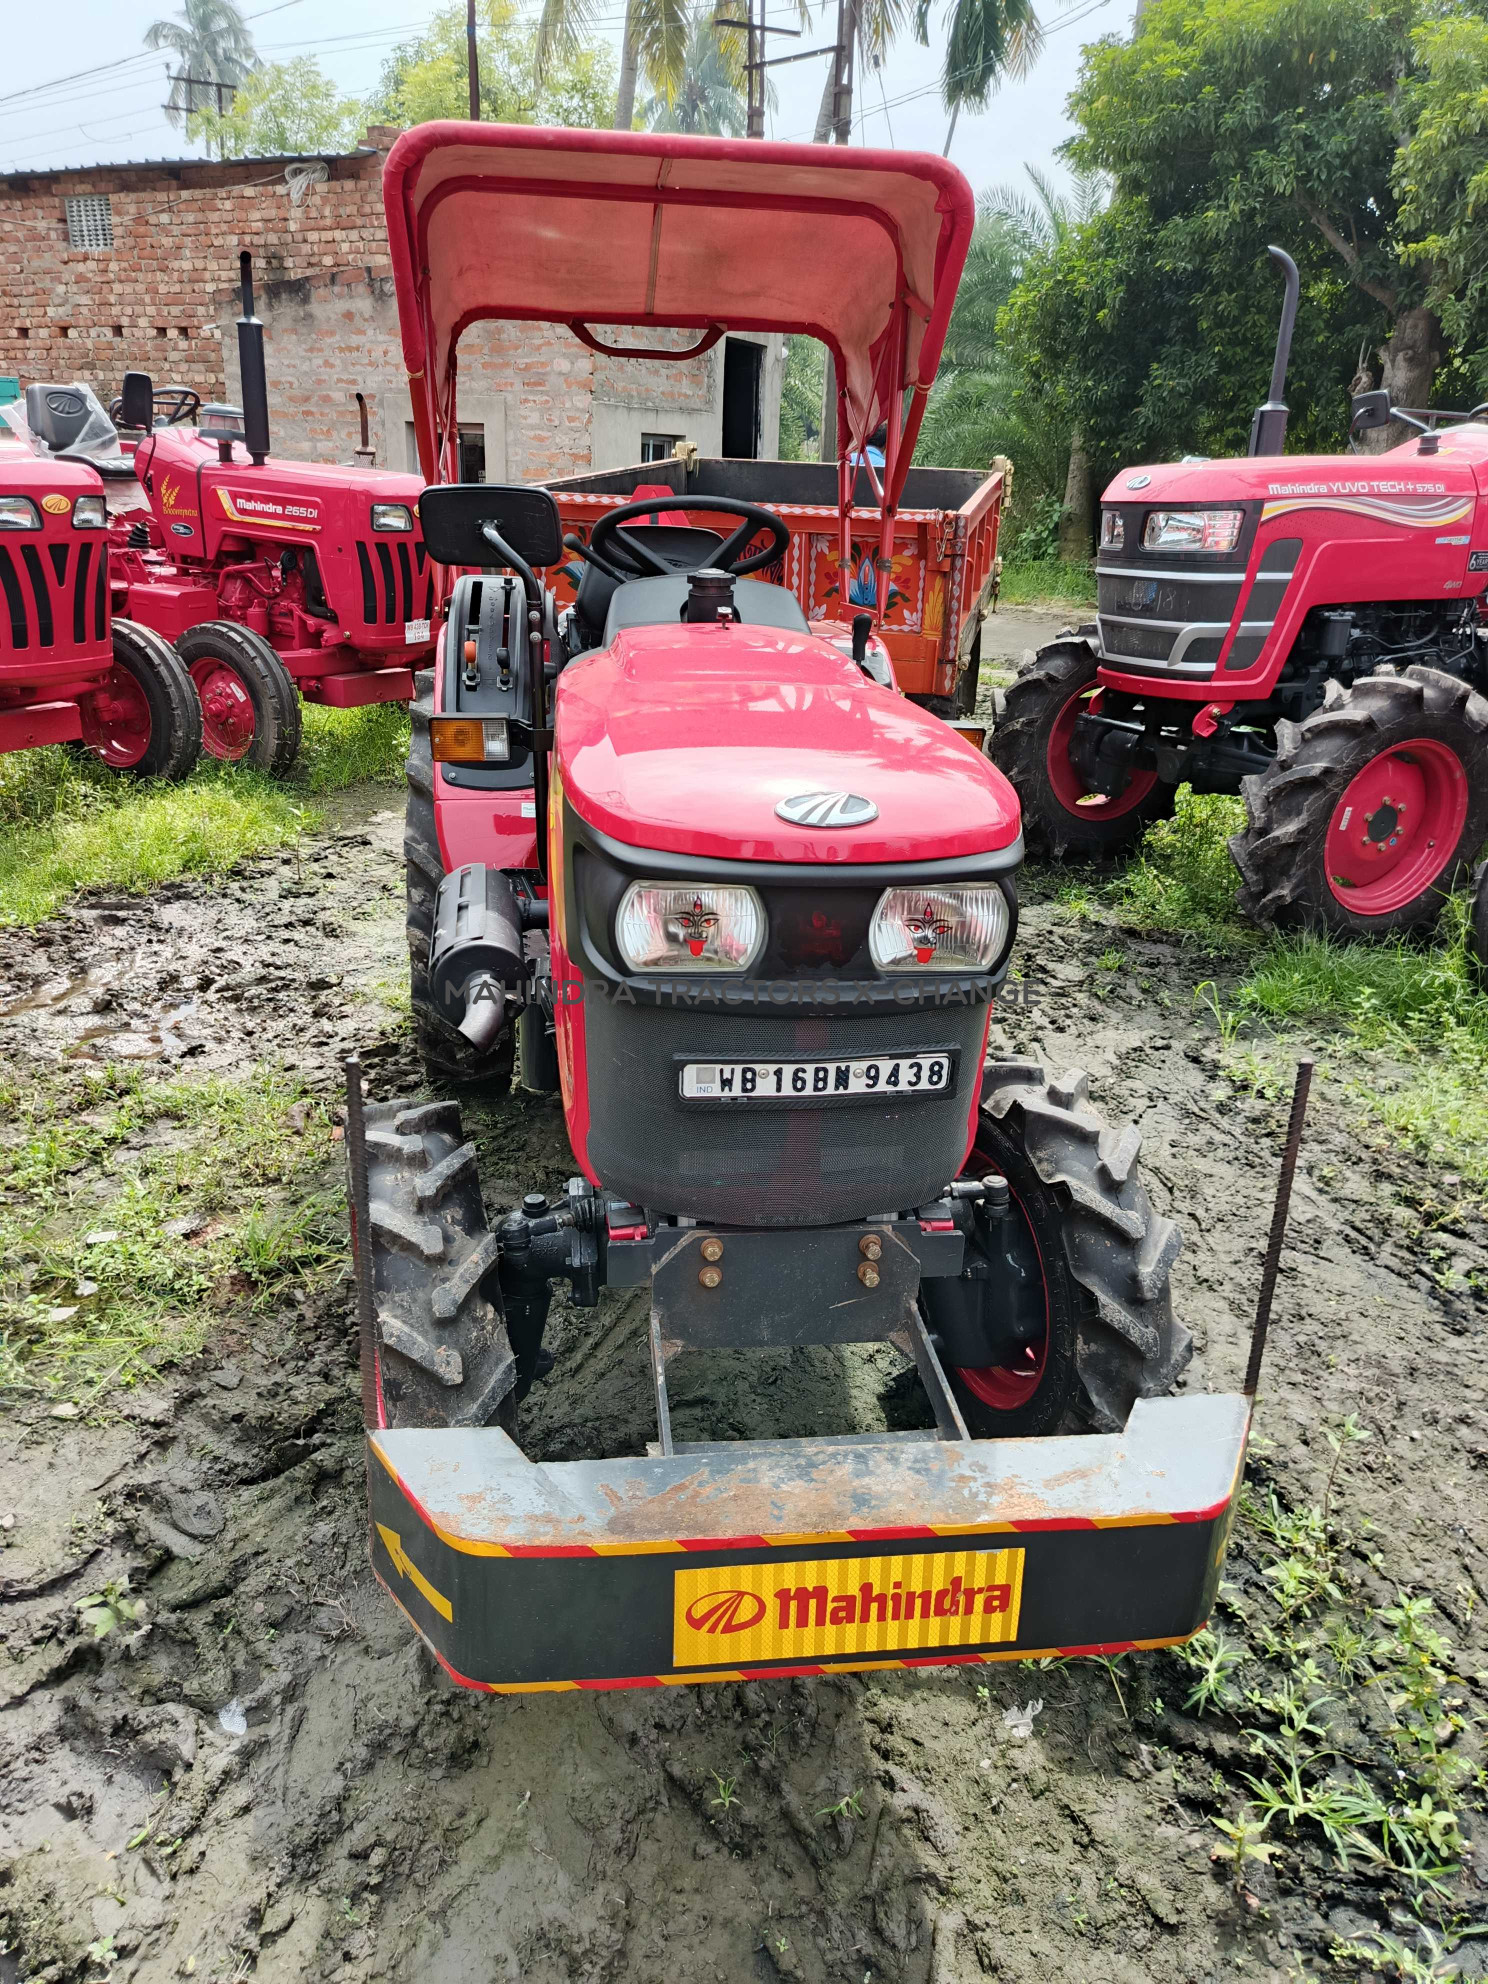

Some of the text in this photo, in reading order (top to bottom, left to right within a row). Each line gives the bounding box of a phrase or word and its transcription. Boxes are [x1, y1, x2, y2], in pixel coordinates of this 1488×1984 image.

[1268, 484, 1328, 495] Mahindra
[1329, 482, 1369, 494] YUVO
[1416, 484, 1434, 493] 575
[236, 498, 283, 514] Mahindra
[1469, 554, 1477, 570] 6
[719, 1067, 757, 1094] WB
[865, 1060, 945, 1089] 9438
[696, 1084, 713, 1094] IND
[773, 1575, 1012, 1630] Mahindra
